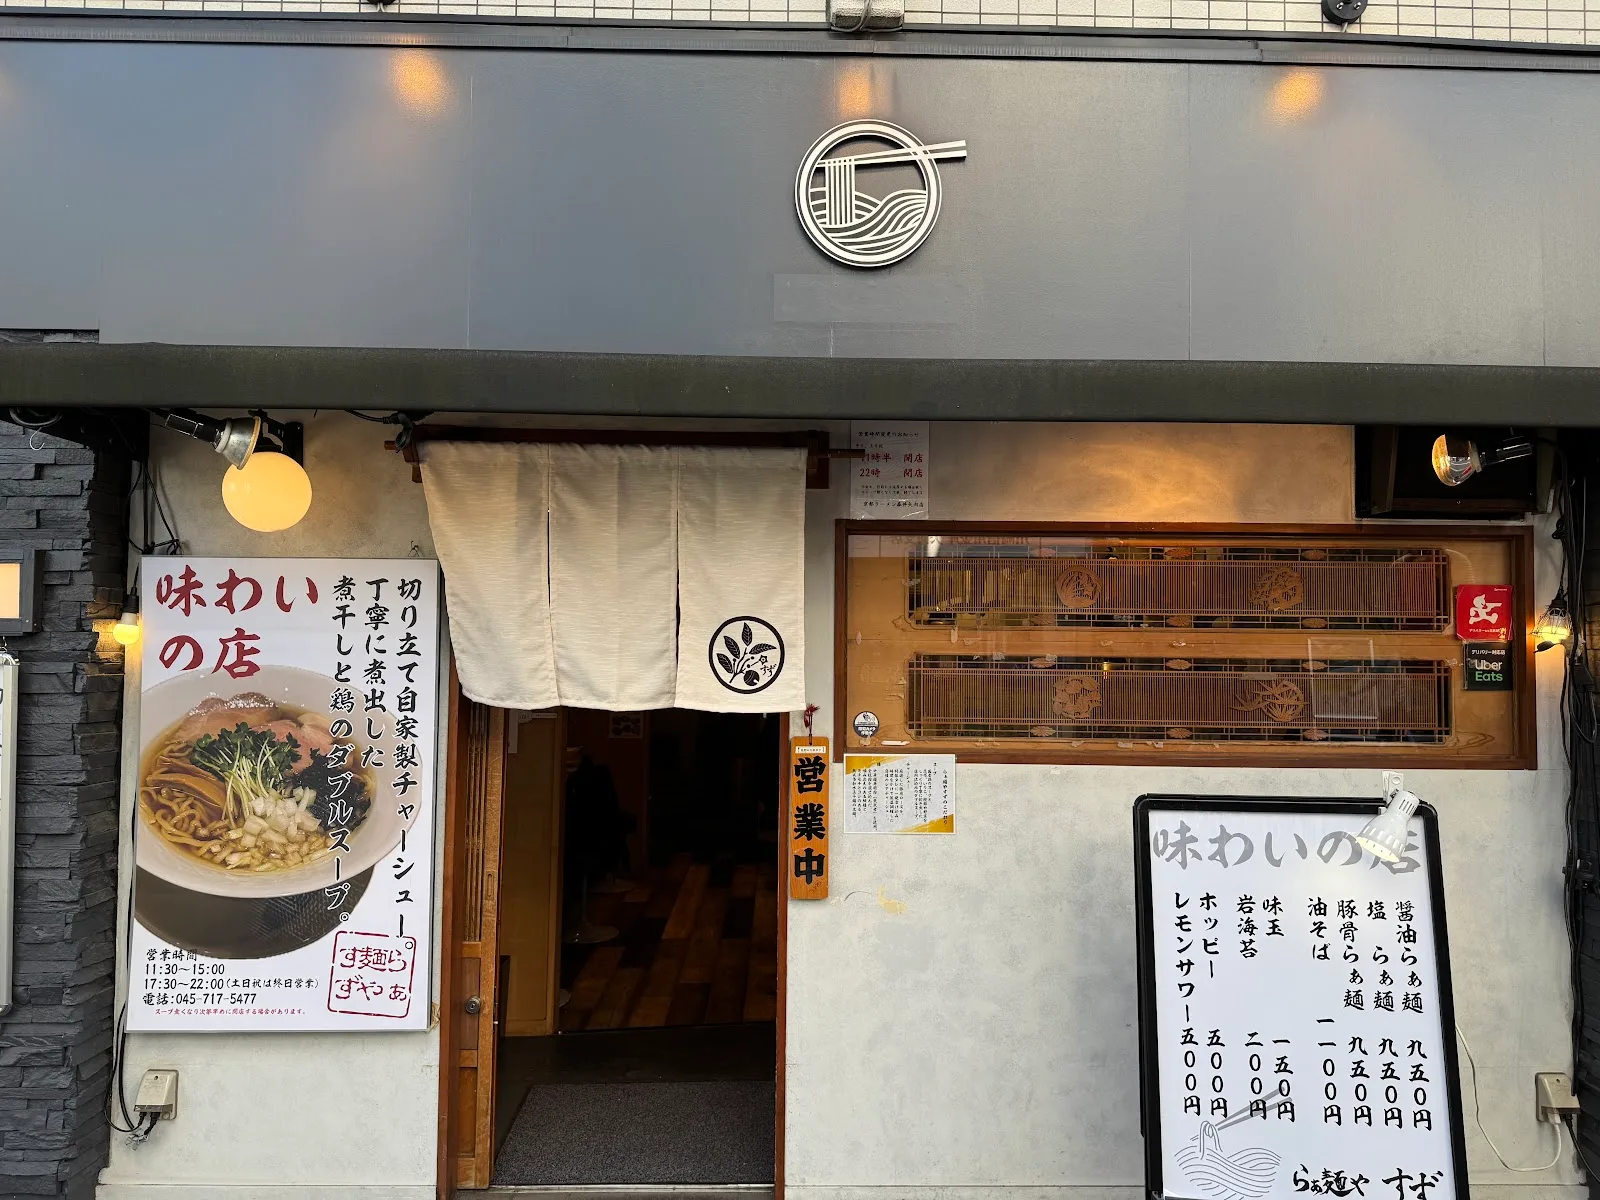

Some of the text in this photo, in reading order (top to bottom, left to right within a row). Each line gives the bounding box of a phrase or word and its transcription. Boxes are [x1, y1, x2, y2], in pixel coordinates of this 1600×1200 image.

[156, 564, 319, 617] 味わい
[159, 627, 262, 680] の店
[361, 576, 390, 769] 丁寧に煮出した
[1475, 659, 1503, 671] Uber
[1475, 671, 1503, 681] Eats
[793, 755, 827, 886] 営業中
[1199, 892, 1221, 979] ホッピー
[1236, 894, 1259, 960] 岩海苔
[1262, 895, 1285, 938] 味玉
[1307, 897, 1331, 961] 油そば
[1366, 900, 1388, 921] 塩
[145, 949, 198, 962] 営業時間
[1174, 892, 1196, 1023] レモンサワー
[1336, 899, 1365, 1011] 豚骨らぁ麺
[1395, 900, 1424, 1013] 醤油らぁ麺
[1293, 1163, 1444, 1200] らぁ麺や すず
